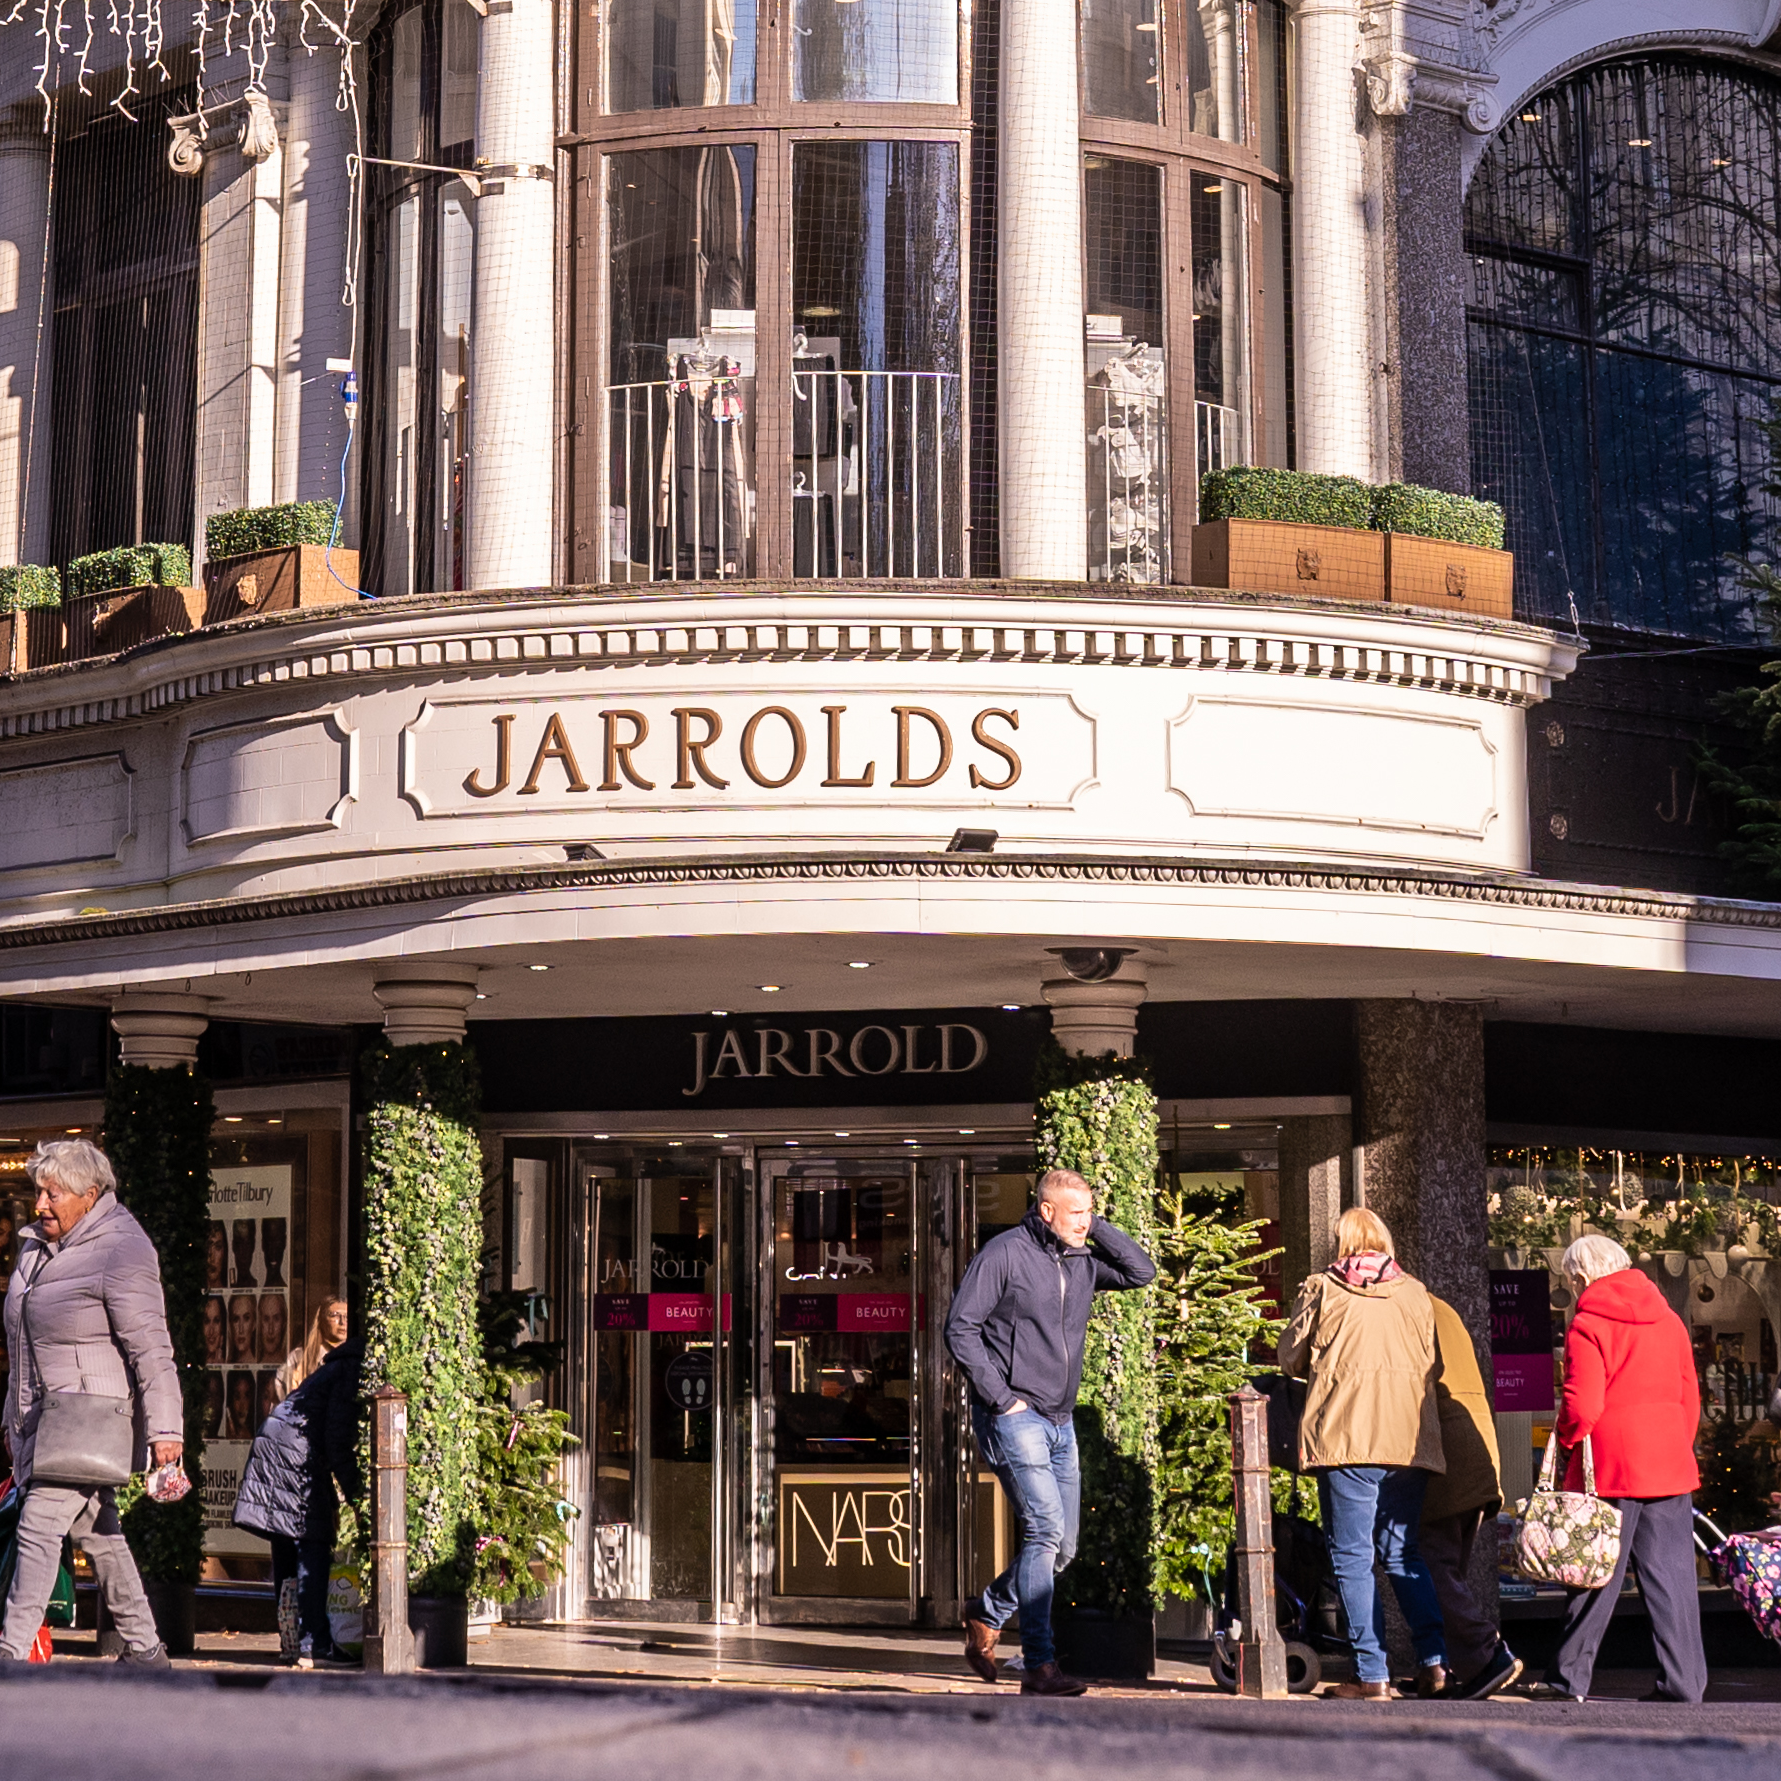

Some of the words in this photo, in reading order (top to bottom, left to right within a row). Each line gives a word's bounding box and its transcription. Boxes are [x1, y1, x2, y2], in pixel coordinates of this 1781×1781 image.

[462, 704, 1023, 797] JARROLDS
[682, 1024, 988, 1096] JARROLD
[1493, 1283, 1520, 1296] SAVE
[665, 1306, 714, 1318] BEAUTY
[856, 1307, 906, 1319] BEAUTY
[1490, 1313, 1530, 1340] 20%
[1495, 1377, 1525, 1388] BEAUTY
[792, 1489, 922, 1567] NARS
